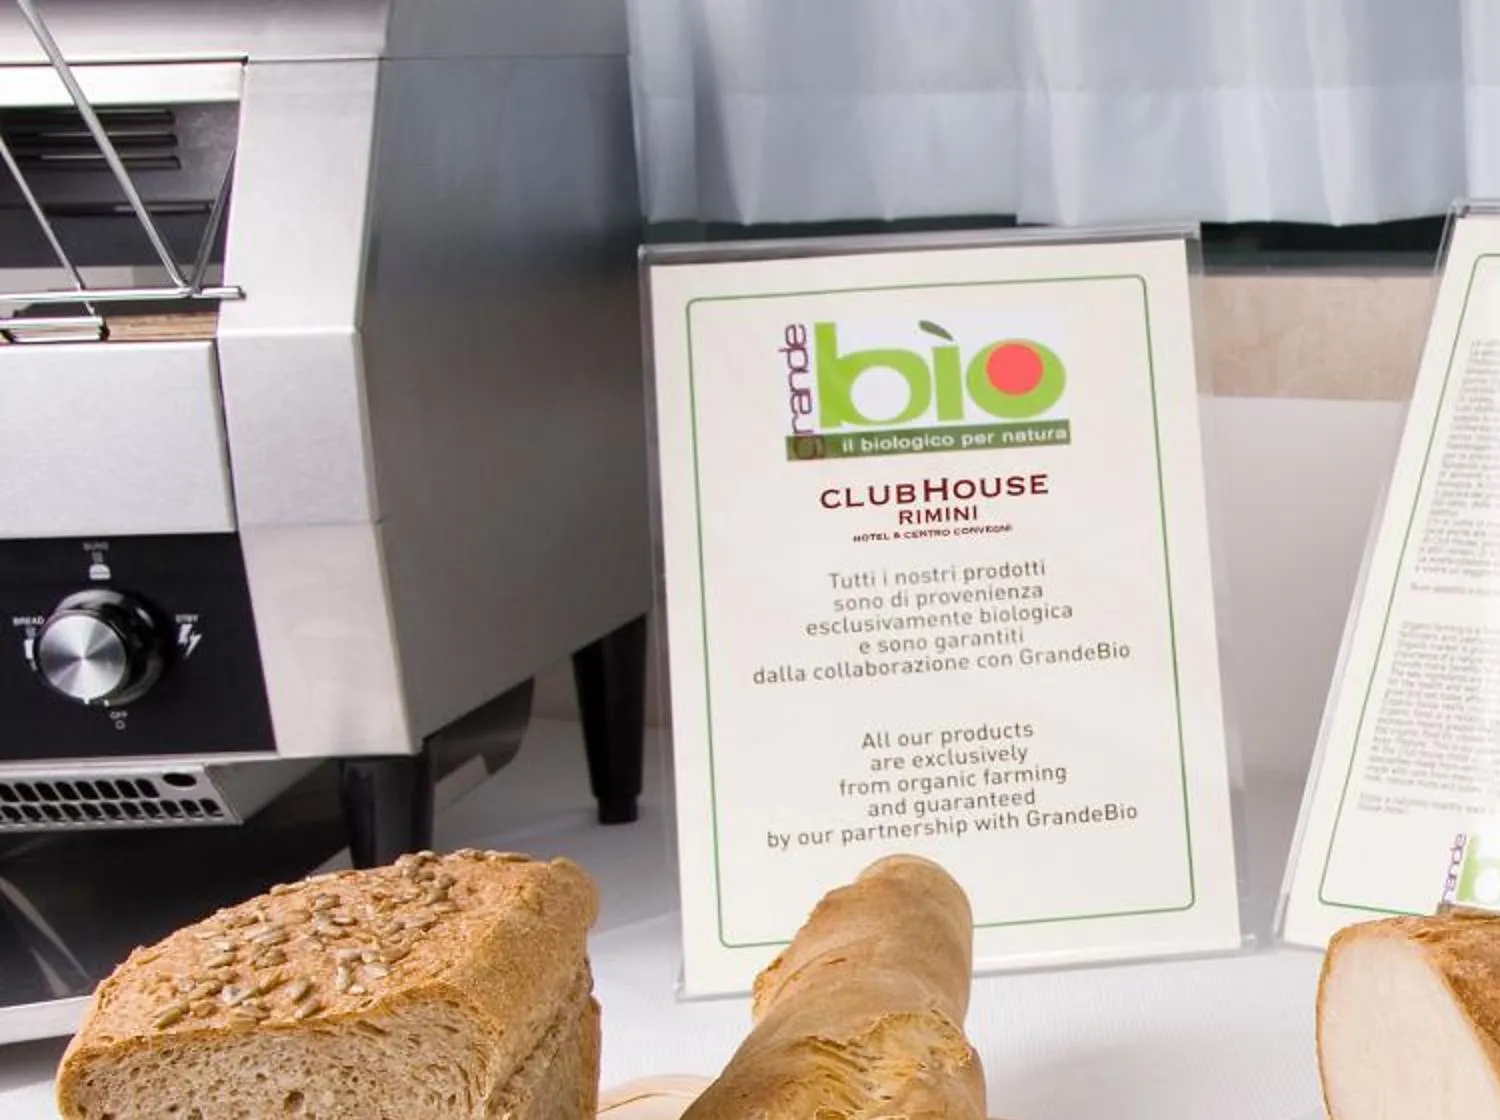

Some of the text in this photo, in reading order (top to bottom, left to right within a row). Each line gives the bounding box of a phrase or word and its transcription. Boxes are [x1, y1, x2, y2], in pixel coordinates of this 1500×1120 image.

[841, 427, 1068, 453] il biologico per natura
[820, 474, 1049, 509] CLUBHOUSE
[898, 505, 978, 525] RIMINI
[852, 531, 890, 545] HOTEL
[904, 528, 951, 540] CENTRO
[827, 559, 1046, 590] Tutti i nostri prodotti
[833, 584, 1044, 613] sono di provenienza
[13, 615, 45, 626] BREAD
[805, 602, 1074, 637] esclusivamente biologica
[858, 628, 1025, 655] e sono garantiti
[752, 641, 1131, 685] dalla collaborazione con GrandeBio
[860, 722, 1035, 752] All our products
[869, 744, 1029, 772] are exclusively
[839, 765, 1068, 796] from organic farming
[867, 788, 1036, 818] and guaranteed
[766, 803, 1138, 850] by our partnership with GrandeBio
[1442, 833, 1467, 904] rande
